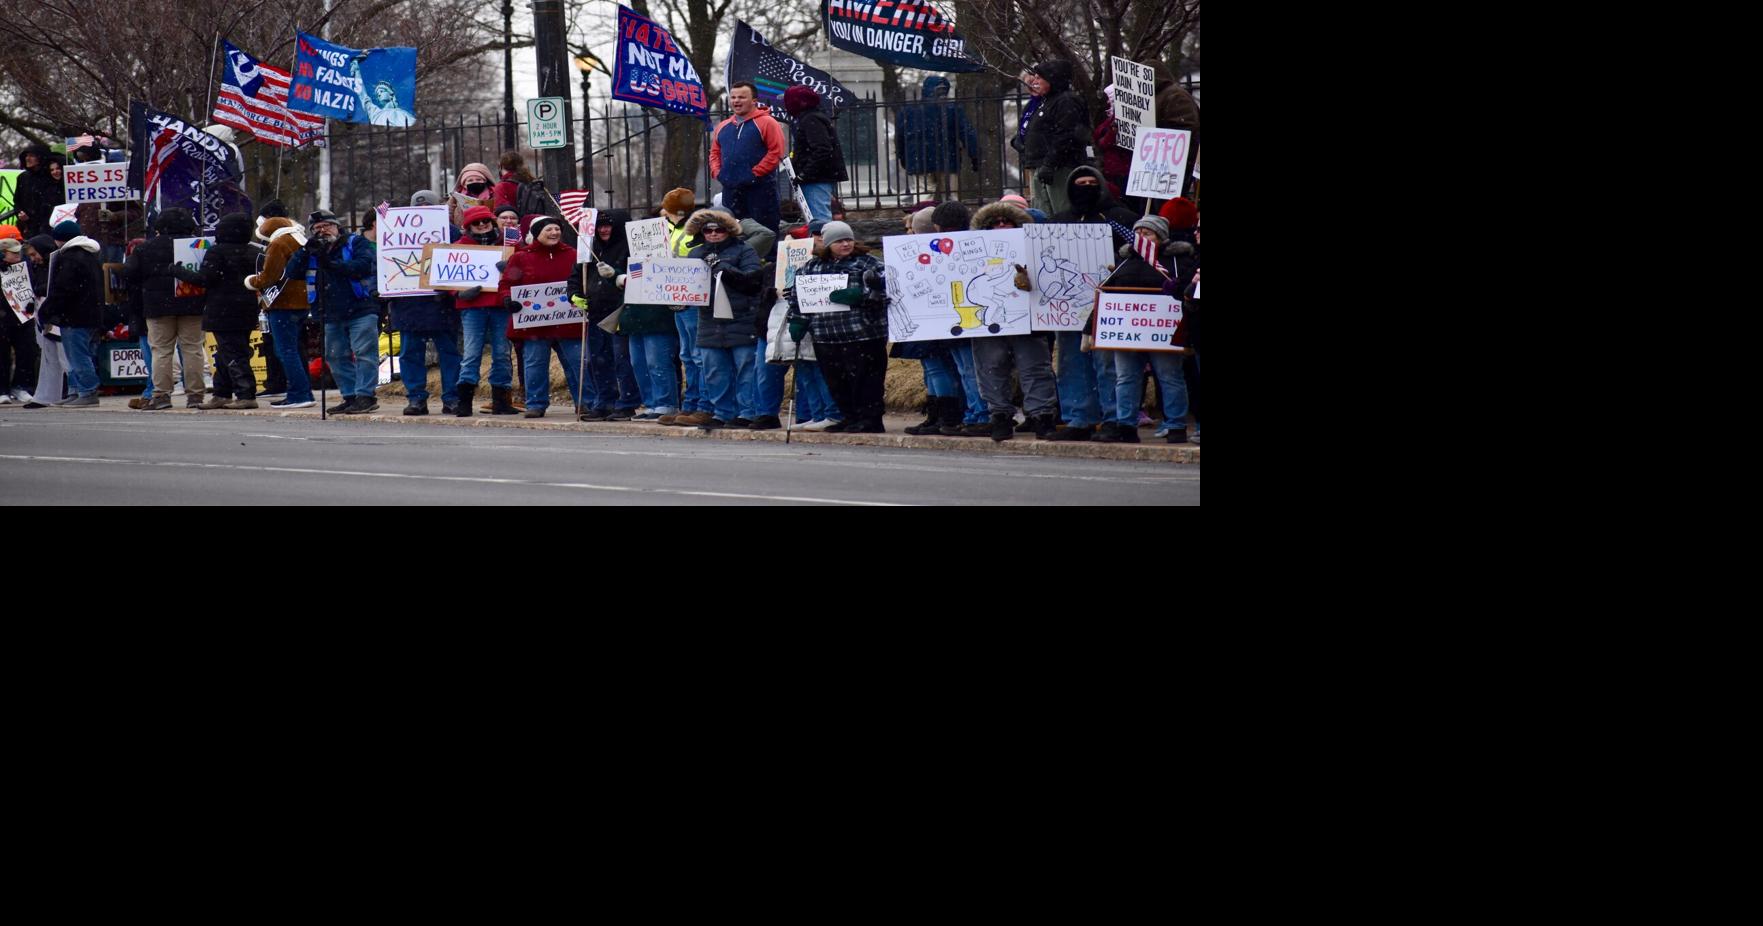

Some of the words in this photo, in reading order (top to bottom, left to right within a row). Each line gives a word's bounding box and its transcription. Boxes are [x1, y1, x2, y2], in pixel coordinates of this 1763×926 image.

[831, 20, 851, 41] YOU
[852, 26, 864, 45] IN
[867, 28, 926, 58] DANGER,
[932, 37, 966, 59] GIRL
[628, 42, 664, 74] NOT
[299, 61, 314, 78] NO
[1113, 57, 1140, 78] YOU'RE
[1143, 68, 1153, 82] SO
[630, 69, 660, 96] US
[1137, 82, 1154, 97] YOU
[295, 83, 312, 101] NO
[314, 88, 355, 111] NAZIS
[1115, 88, 1150, 111] PROBABLY
[540, 104, 552, 118] P
[1121, 105, 1142, 124] THINK
[542, 122, 557, 130] HOUR
[1115, 119, 1130, 135] THIS
[148, 115, 229, 161] HANDS
[1116, 133, 1136, 150] ABOU
[1140, 131, 1186, 165] GTFO
[1131, 170, 1178, 195] HOUSE
[394, 213, 423, 228] NO
[383, 226, 446, 247] KINGS!
[448, 252, 470, 264] NO
[790, 248, 807, 257] 250
[963, 247, 983, 256] KINGS
[437, 264, 490, 281] WARS
[517, 289, 539, 299] HEY
[1050, 300, 1069, 312] NO
[1105, 302, 1157, 312] SILENCE
[1168, 304, 1181, 313] IS
[518, 312, 552, 324] LOOKING
[551, 309, 567, 321] FOR
[1036, 312, 1079, 326] KINGS
[1100, 317, 1124, 326] NOT
[1131, 318, 1180, 328] GOLDEN
[1100, 331, 1142, 341] SPEAK
